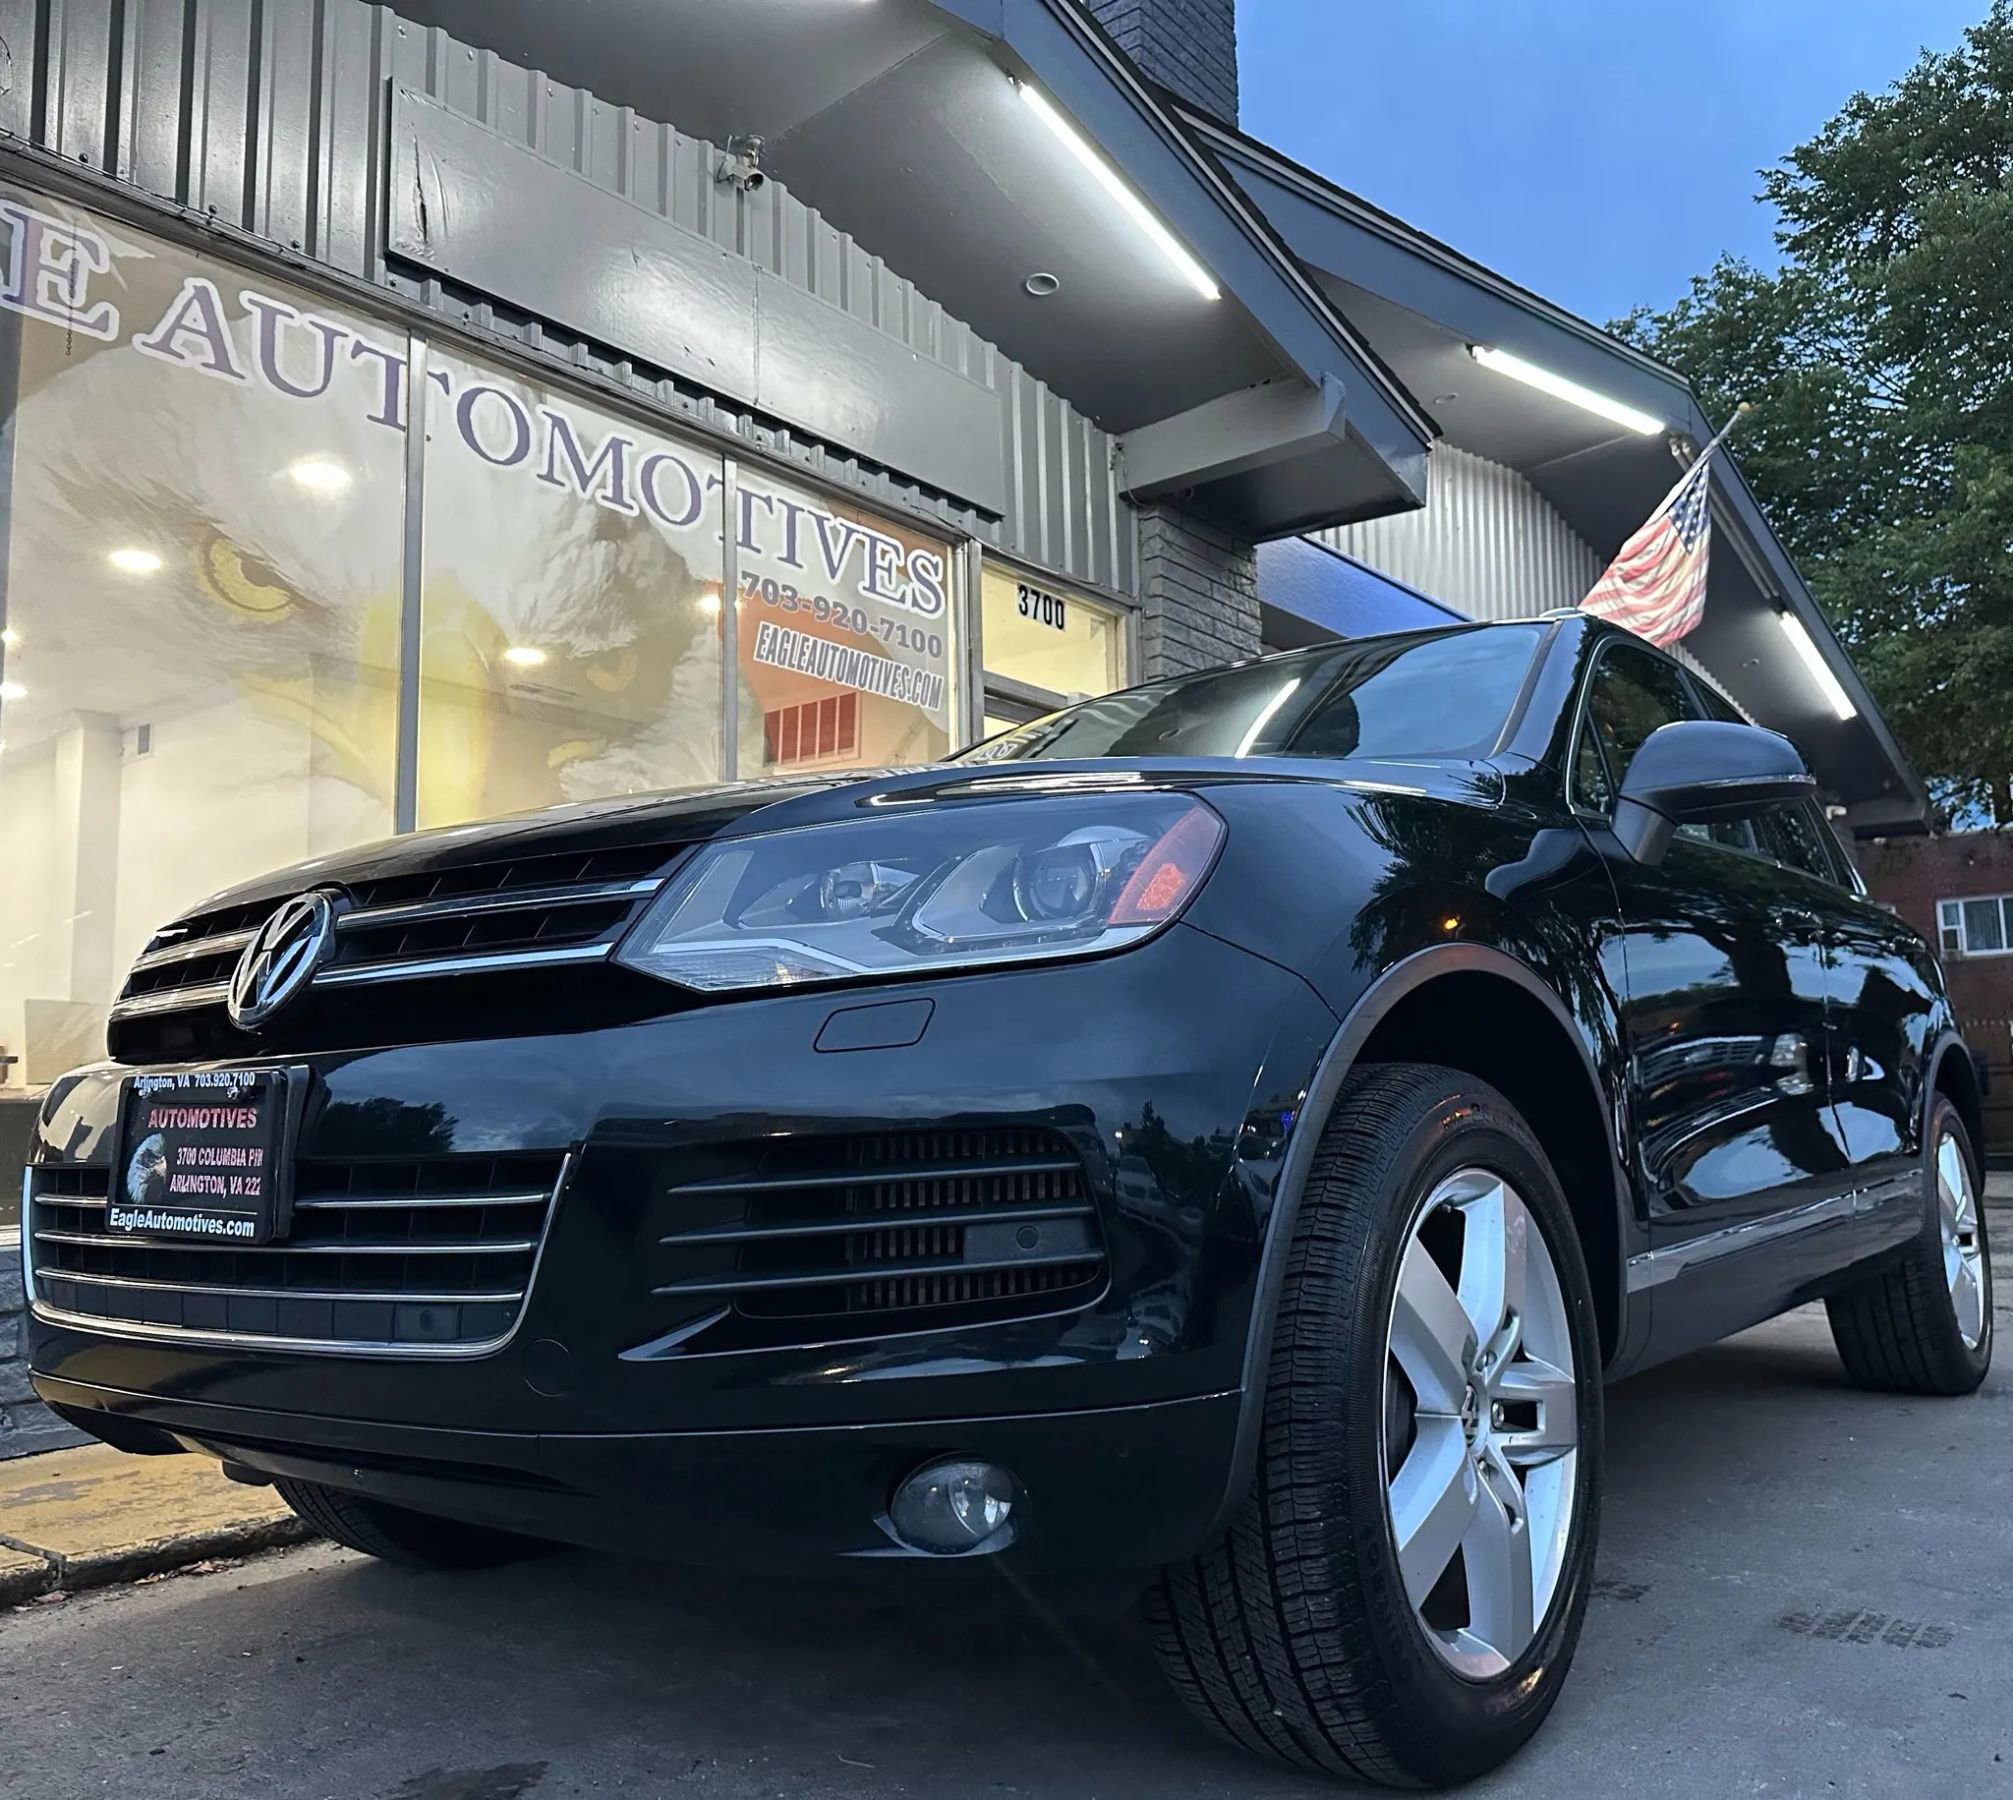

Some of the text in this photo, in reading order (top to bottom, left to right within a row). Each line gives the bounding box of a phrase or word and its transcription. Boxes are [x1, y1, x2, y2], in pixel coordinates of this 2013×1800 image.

[134, 280, 944, 617] AUTOMOTIVES
[741, 570, 943, 659] 703-920-7100
[1018, 584, 1065, 631] 3700
[754, 622, 944, 710] EAGLEAUTOMOTIVES.COM
[133, 1072, 256, 1092] Arlington, VA 703.920.7100
[147, 1107, 258, 1129] AUTOMOTIVES
[176, 1146, 197, 1166] 3700
[198, 1147, 247, 1167] COLUMBIA
[169, 1174, 227, 1199] ARLINGTON,
[229, 1175, 243, 1195] VA
[109, 1207, 256, 1238] EagleAutomotives.com
